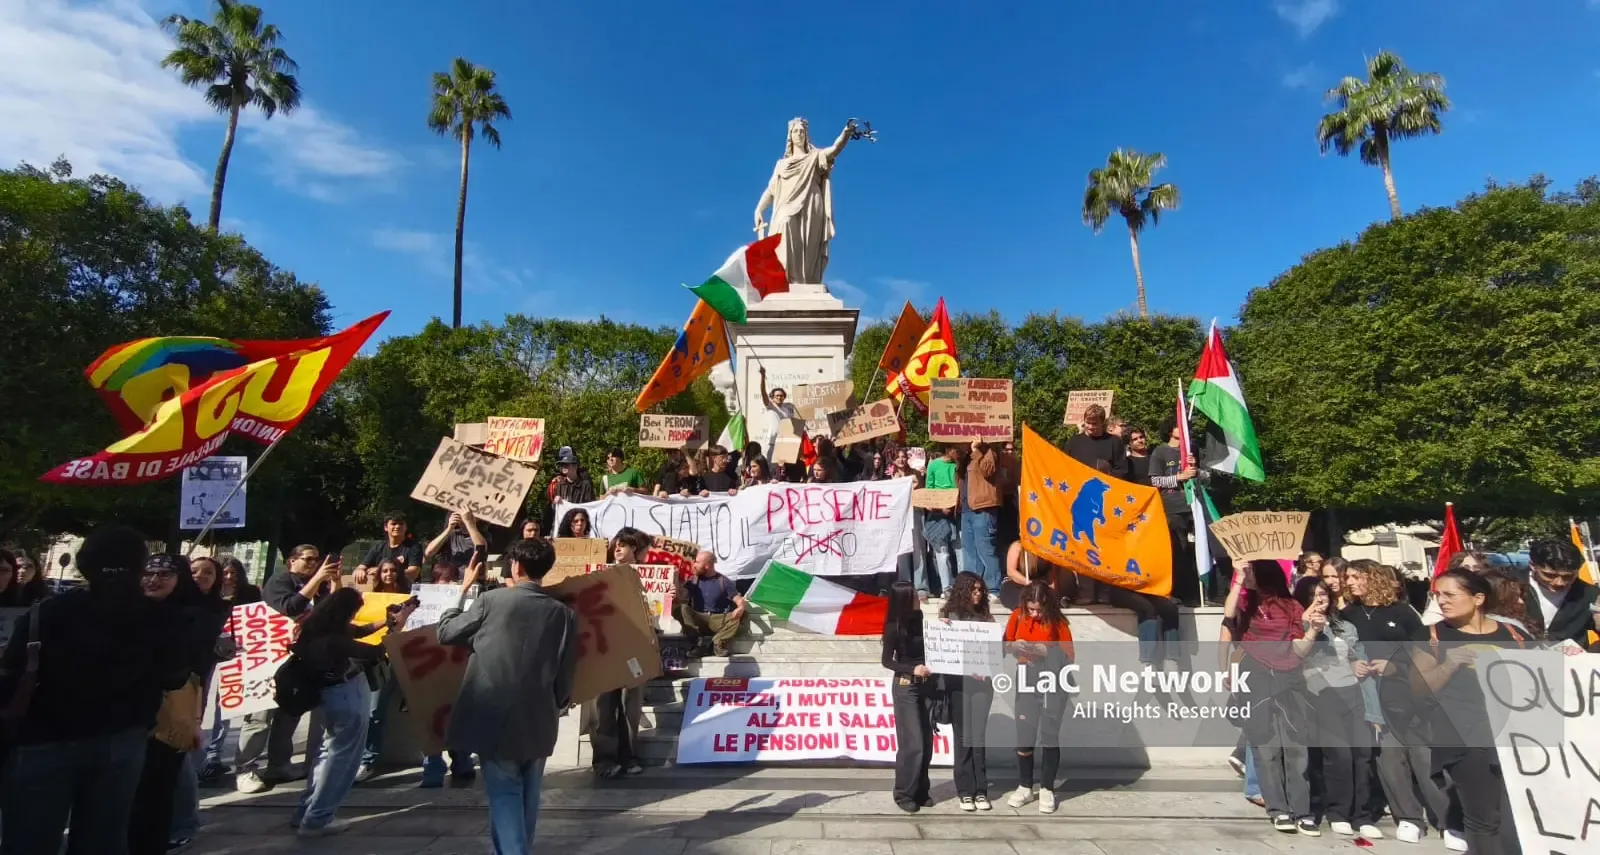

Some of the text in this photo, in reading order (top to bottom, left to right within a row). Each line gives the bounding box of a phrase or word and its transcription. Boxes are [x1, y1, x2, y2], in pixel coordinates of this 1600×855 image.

[649, 502, 732, 560] SIAMO
[740, 515, 760, 548] IL
[766, 487, 892, 532] PRESENTE
[782, 531, 857, 559] FUTURO
[1259, 530, 1296, 552] STATO
[246, 604, 268, 671] SOGNA
[697, 692, 895, 710] I PREZZI, I MUTUI E L
[747, 712, 821, 728] ALZATE
[827, 711, 833, 727] I
[713, 733, 739, 752] LE
[744, 732, 839, 752] PENSIONI
[845, 733, 858, 751] E
[864, 734, 870, 751] I
